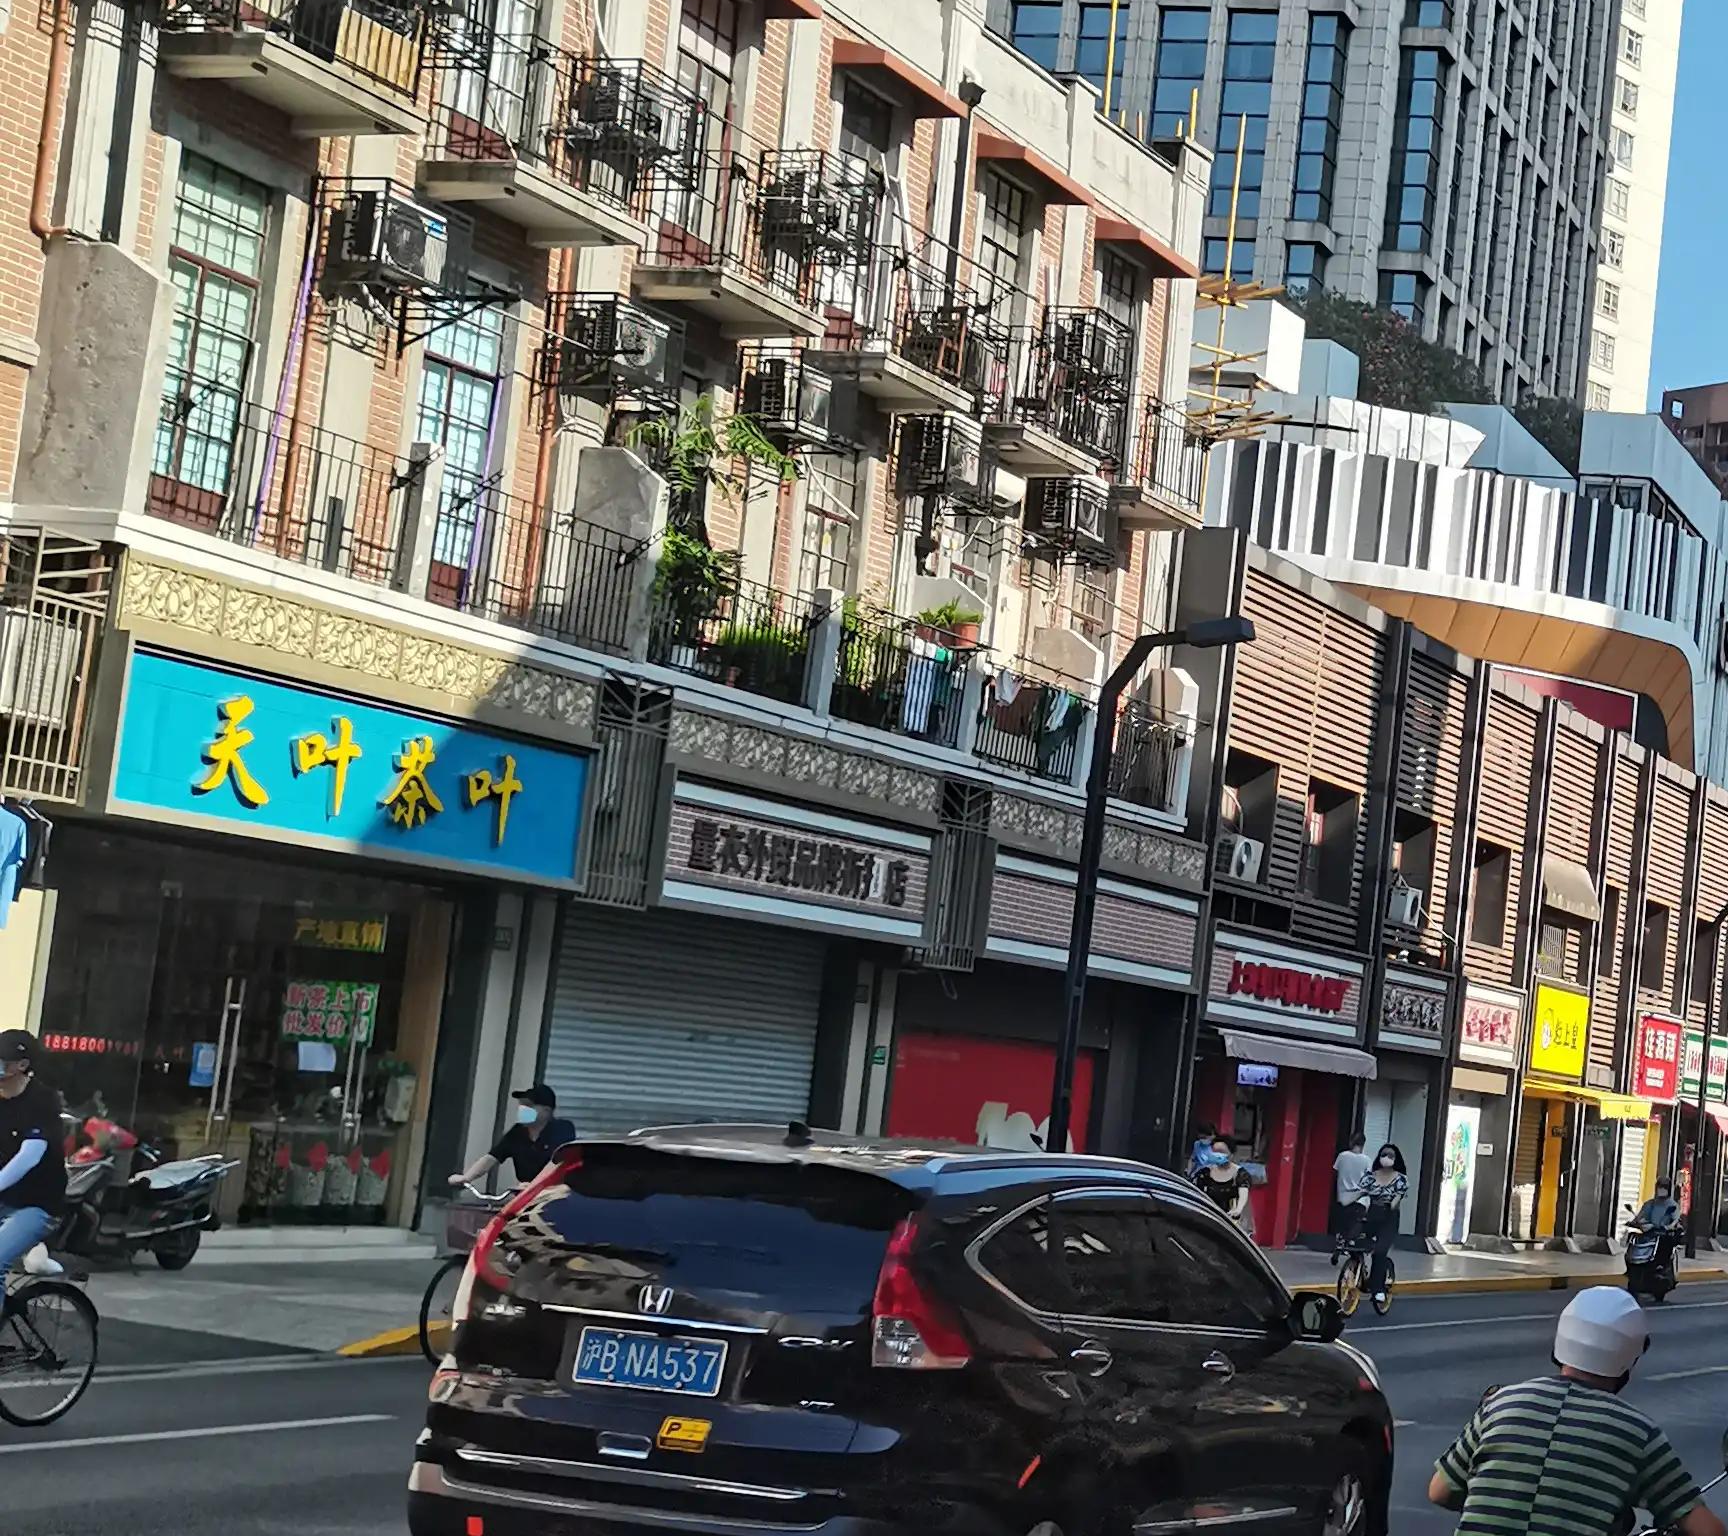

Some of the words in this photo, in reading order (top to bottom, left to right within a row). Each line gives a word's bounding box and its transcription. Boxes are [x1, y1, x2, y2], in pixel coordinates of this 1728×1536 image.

[195, 695, 524, 845] 天叶茶叶
[284, 982, 376, 1013] 新茶上市
